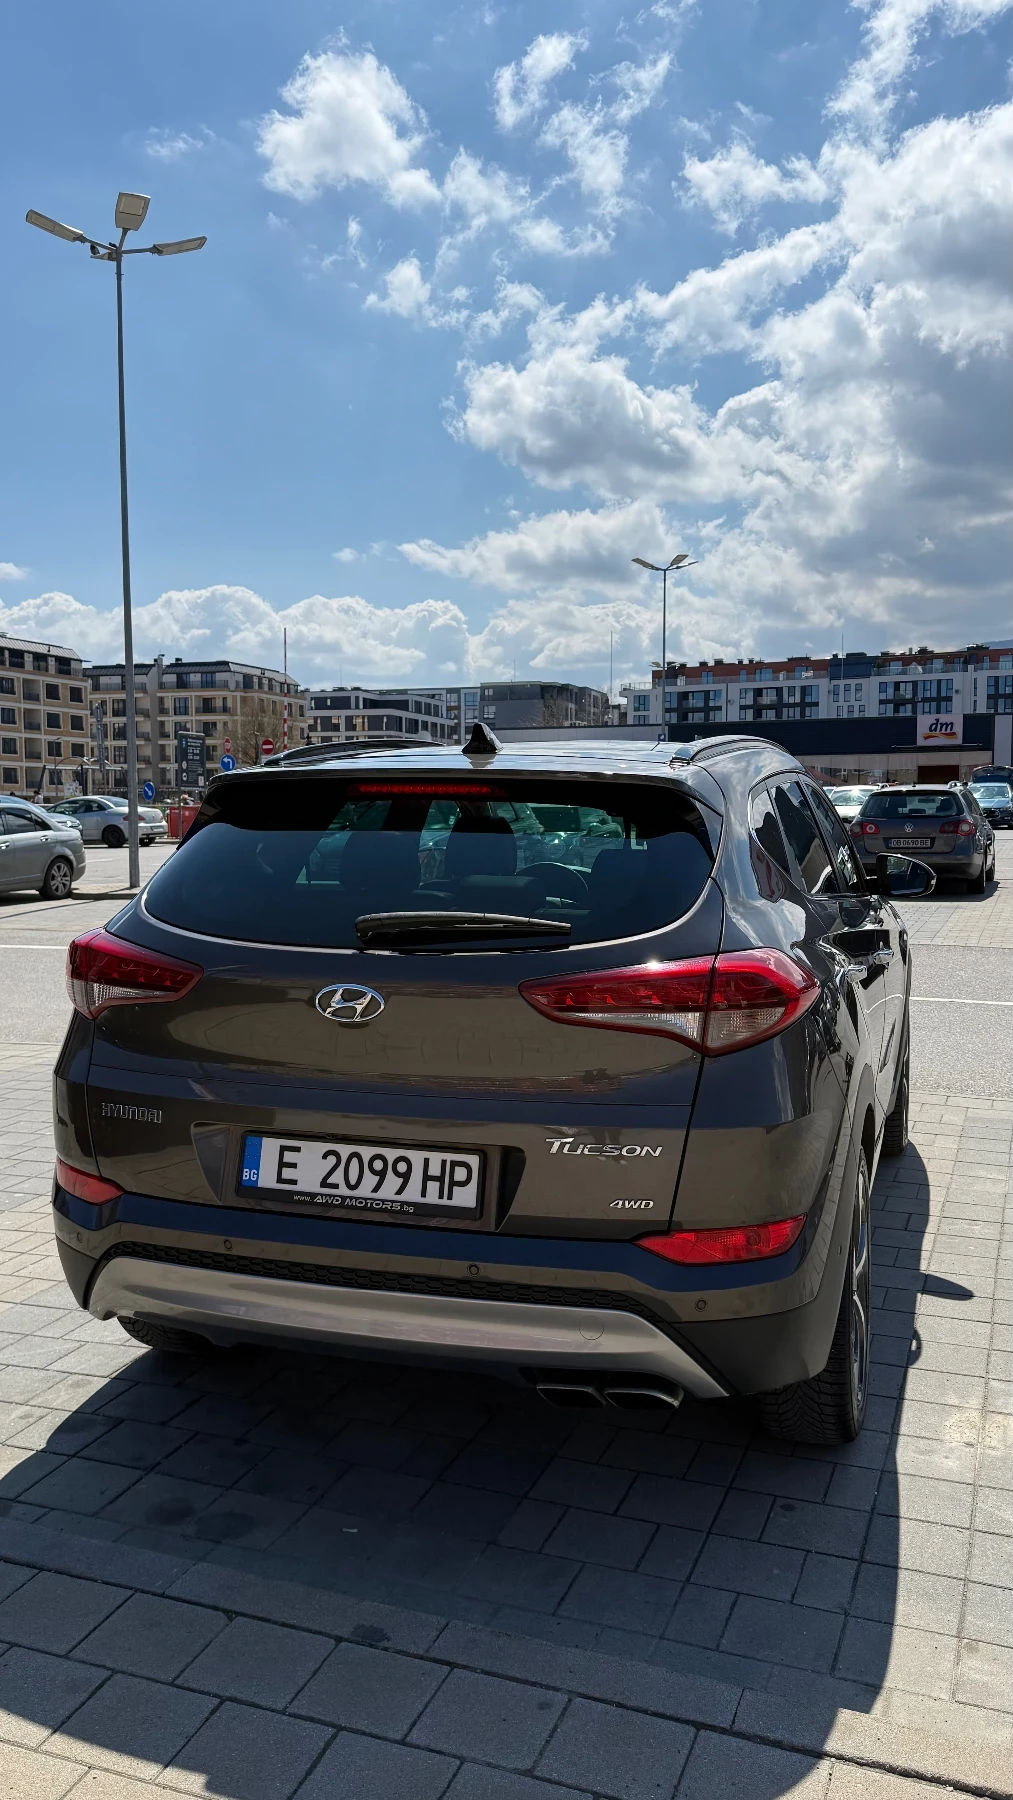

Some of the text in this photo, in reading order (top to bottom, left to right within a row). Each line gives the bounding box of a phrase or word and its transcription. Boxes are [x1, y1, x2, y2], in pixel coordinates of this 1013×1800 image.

[929, 718, 954, 732] dm
[101, 1102, 162, 1123] HYUNDAI
[545, 1137, 663, 1157] TUCSON
[275, 1144, 302, 1186] E
[242, 1168, 258, 1181] BG
[609, 1199, 654, 1209] 4WD
